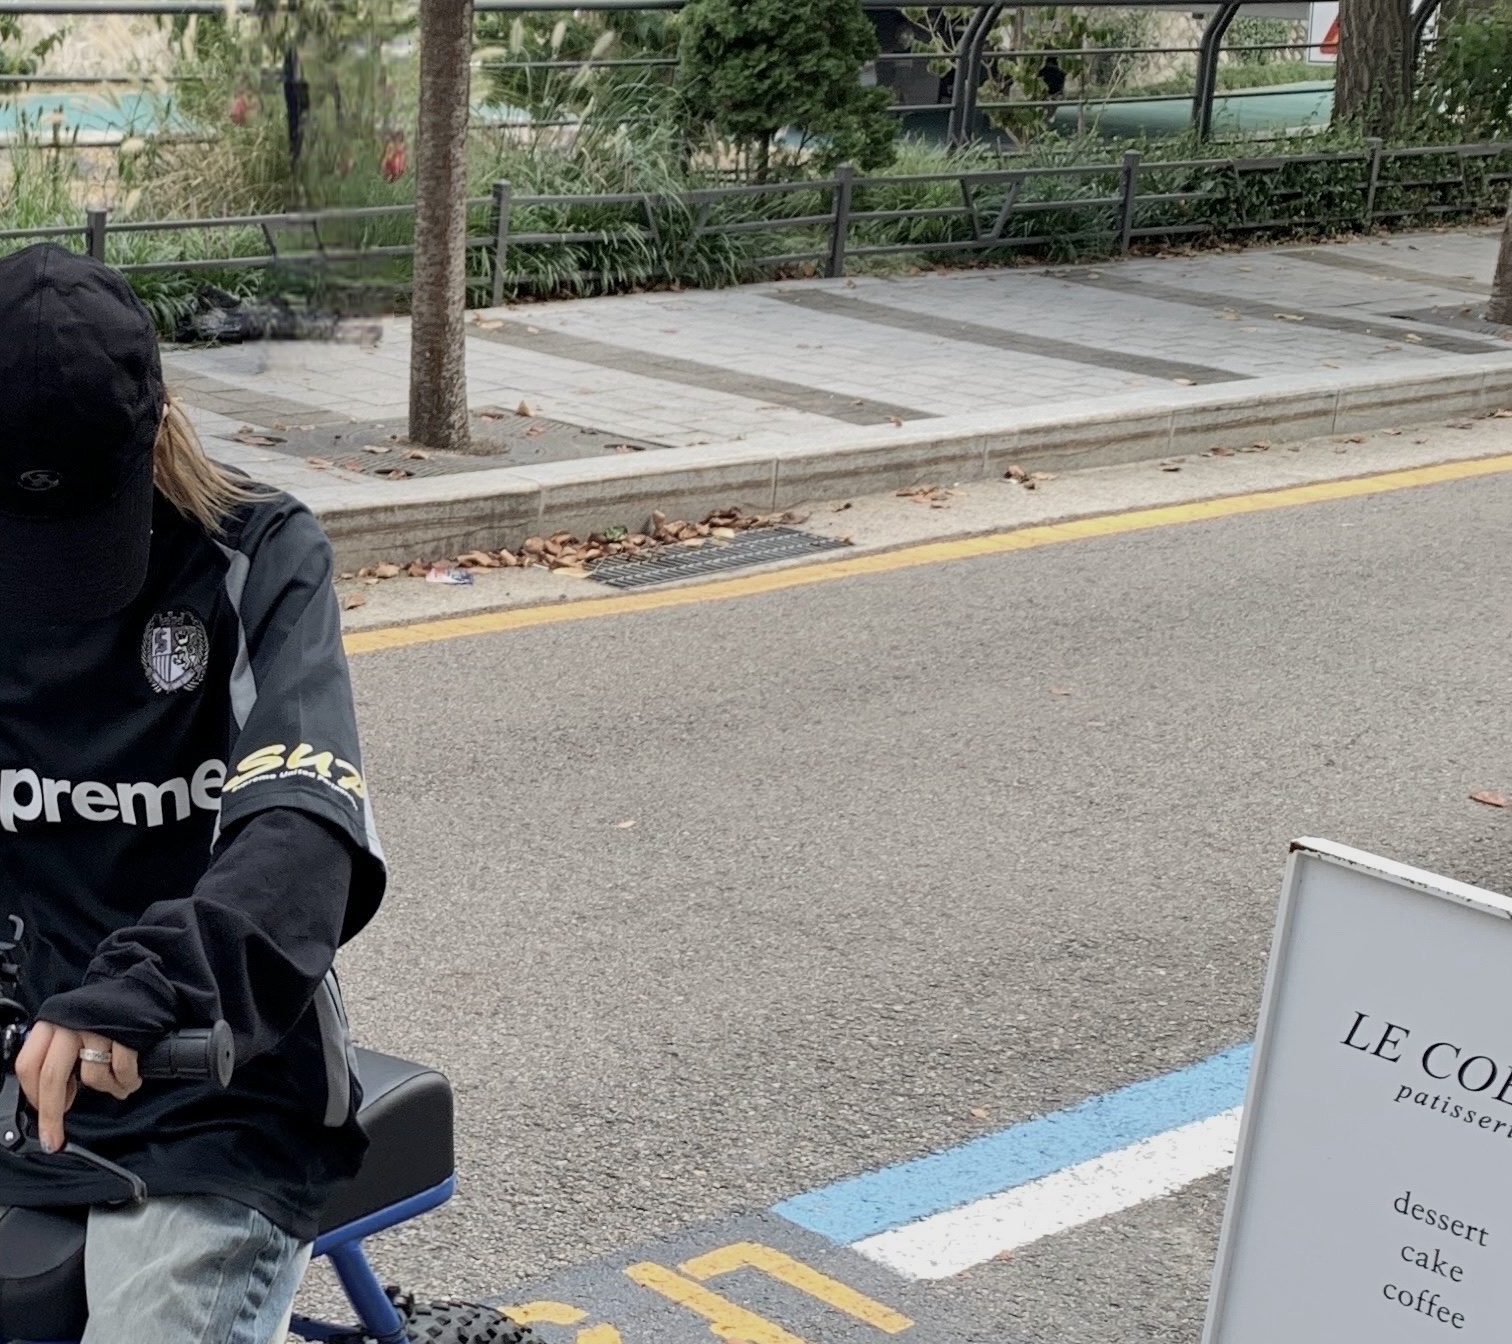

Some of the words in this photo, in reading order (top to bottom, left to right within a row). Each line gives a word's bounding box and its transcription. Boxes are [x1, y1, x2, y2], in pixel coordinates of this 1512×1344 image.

[1340, 1010, 1410, 1063] LE
[1393, 1190, 1489, 1247] dessert
[1401, 1245, 1464, 1293] cake
[1383, 1283, 1465, 1329] coffee
